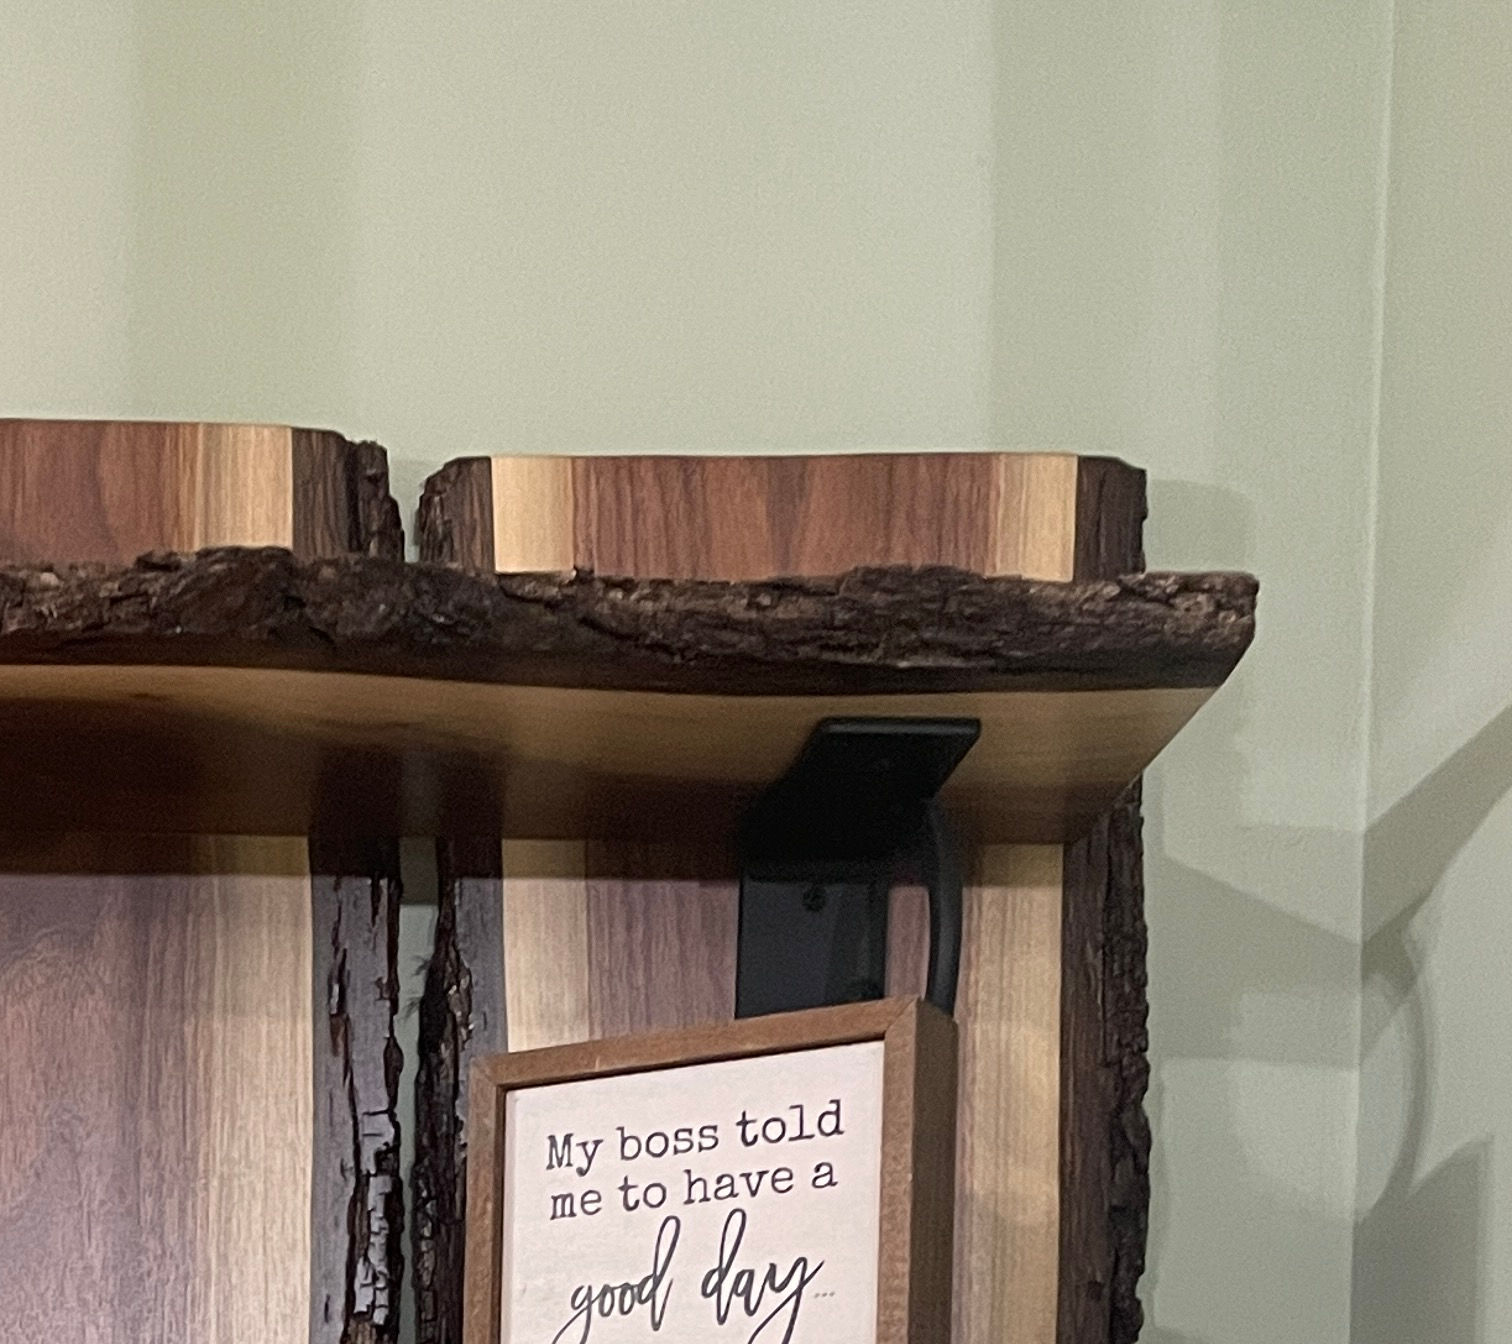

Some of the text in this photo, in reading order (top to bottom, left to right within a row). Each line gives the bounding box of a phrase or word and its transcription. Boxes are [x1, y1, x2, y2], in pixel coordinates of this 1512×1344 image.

[546, 1099, 844, 1176] My boss told
[550, 1161, 838, 1220] me to have a
